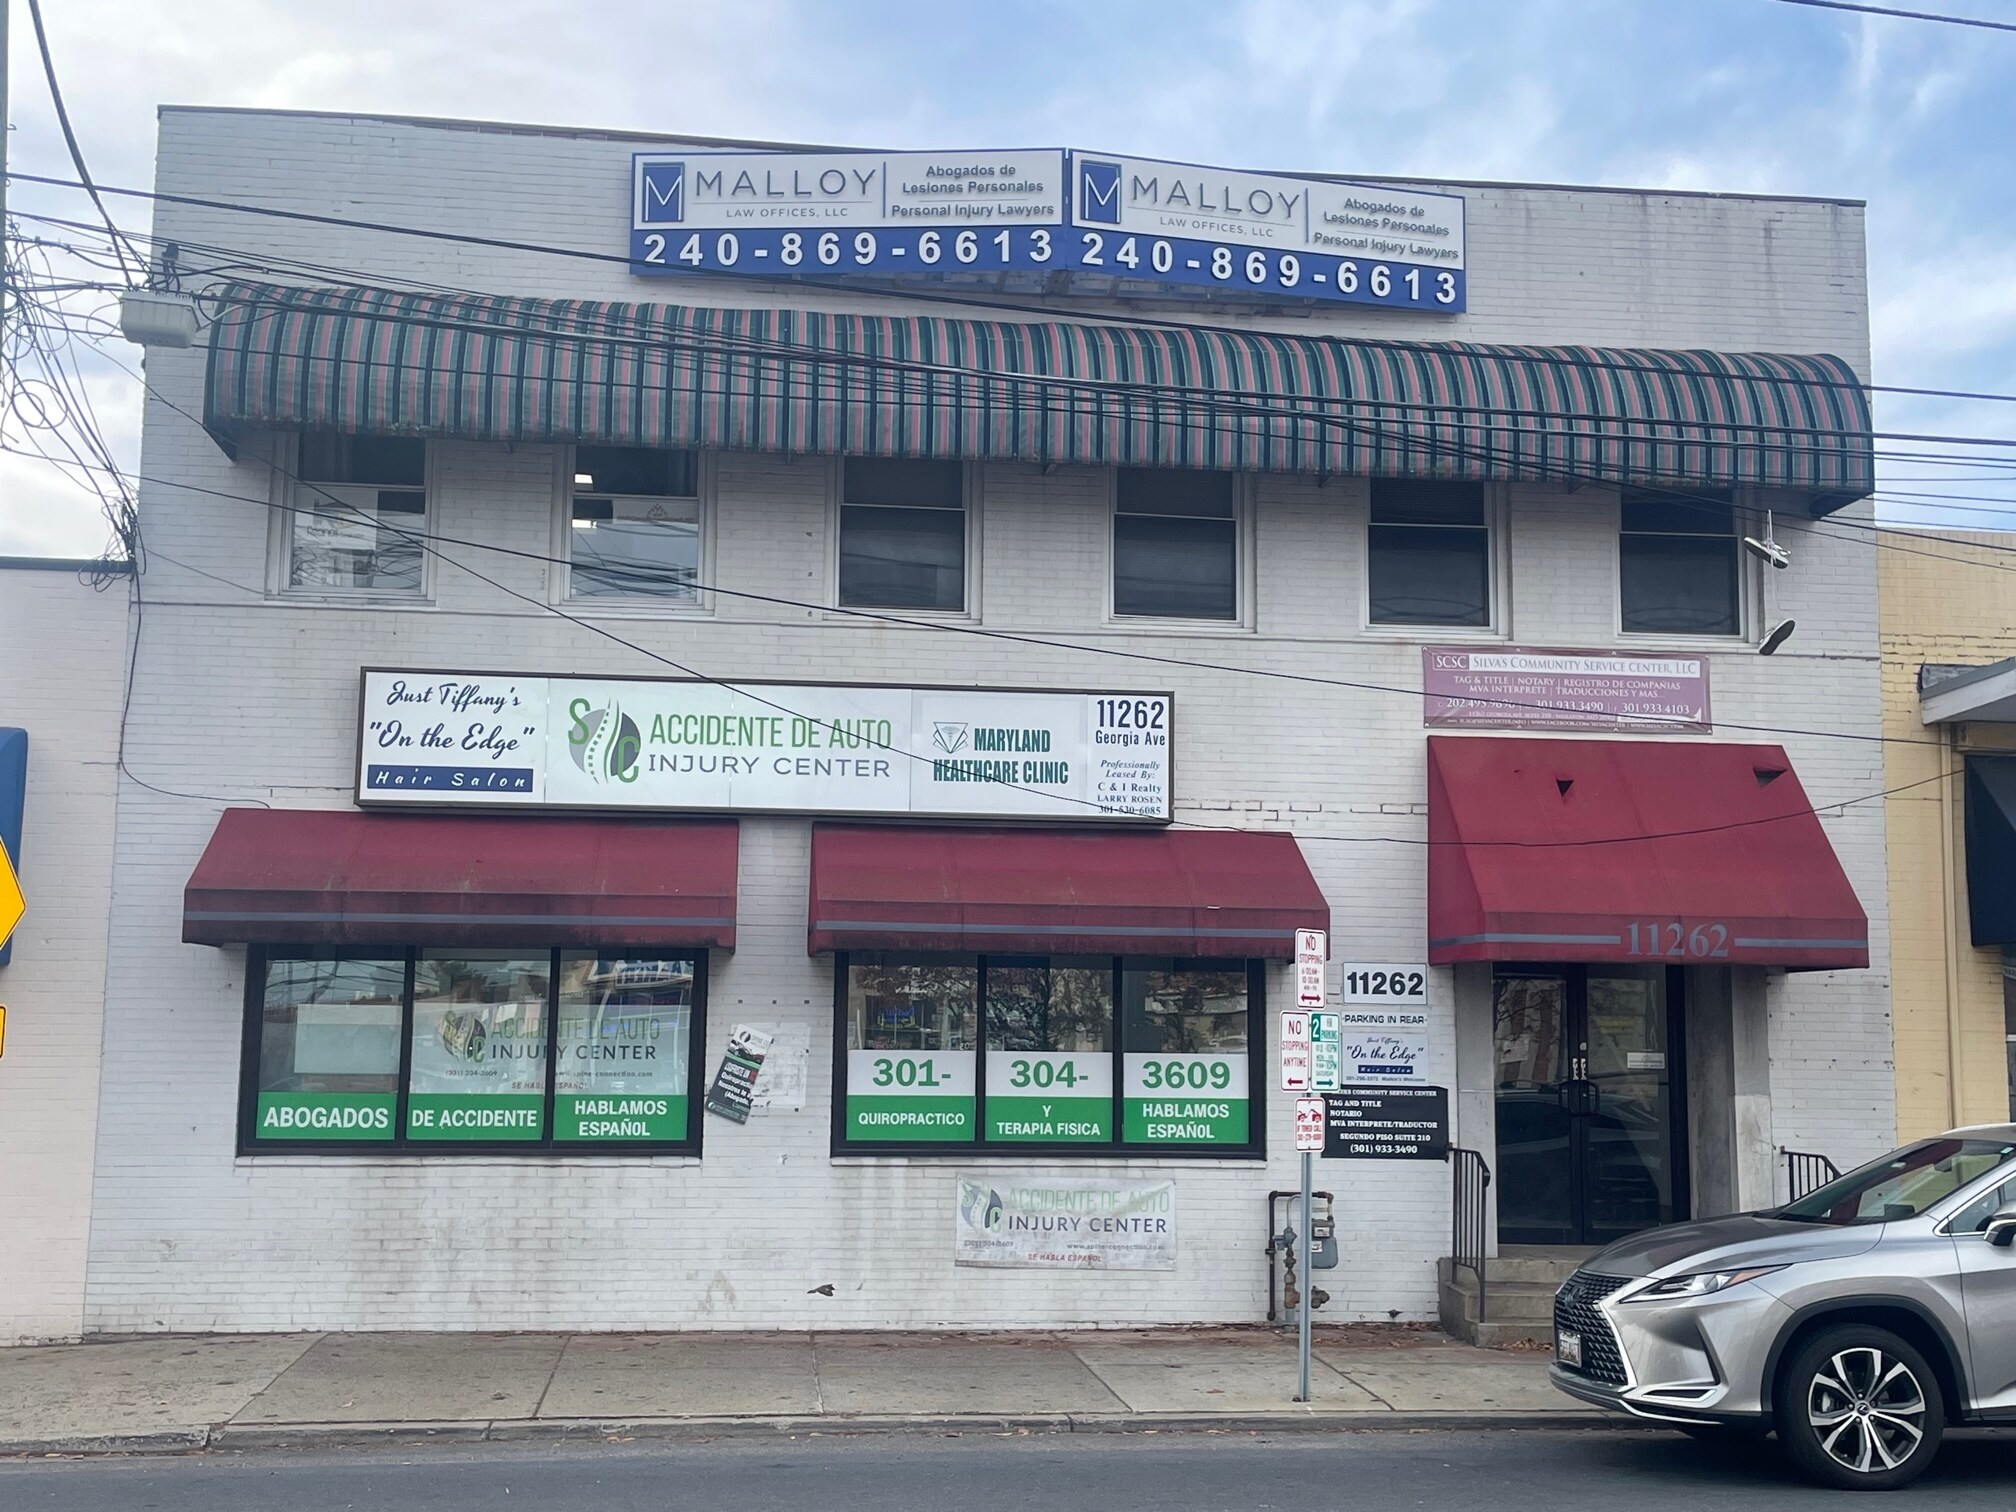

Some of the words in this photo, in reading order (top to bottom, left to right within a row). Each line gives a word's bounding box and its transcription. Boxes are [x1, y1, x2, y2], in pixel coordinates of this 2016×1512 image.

[926, 165, 995, 179] Abogados
[1000, 164, 1016, 175] de
[696, 169, 876, 197] MALLOY
[902, 182, 963, 194] Lesiones
[968, 180, 1044, 193] Personales
[1132, 175, 1300, 219] MALLOY
[726, 208, 755, 218] LAW
[760, 207, 820, 219] OFFICES,
[825, 207, 848, 217] LLC
[892, 205, 950, 217] Personal
[955, 204, 994, 218] Injury
[998, 204, 1054, 217] Lawyers
[1344, 198, 1407, 215] Abogados
[1410, 206, 1425, 217] de
[1160, 217, 1187, 228] LAW
[1192, 221, 1247, 236] OFFICES,
[1251, 227, 1273, 238] LLC
[1323, 211, 1379, 228] Lesiones
[1382, 218, 1450, 237] Personales
[643, 229, 1053, 267] 240-869-6613
[1314, 232, 1368, 249] Personal
[1371, 238, 1406, 255] Injury
[1409, 243, 1459, 260] Lawyers
[1081, 232, 1457, 304] 240-869-6613
[1436, 655, 1467, 669] SCSC
[1510, 656, 1580, 670] COMMUNITY
[1583, 660, 1625, 672] SERVICE
[1628, 662, 1672, 674] CENTER,
[1675, 661, 1697, 675] LLC
[1454, 676, 1472, 684] TAG
[1474, 676, 1481, 684] &
[1484, 676, 1509, 684] TITLE
[1517, 677, 1555, 686] NOTARY
[1563, 678, 1610, 688] REGISTRO
[1612, 679, 1624, 689] DE
[386, 681, 432, 707] Just
[438, 682, 521, 715] Tiffany's
[1469, 685, 1489, 693] MVA
[1491, 686, 1546, 695] INTERPRETE
[1556, 687, 1629, 698] TRADUCCIONES
[1630, 689, 1638, 698] Y
[1097, 700, 1164, 729] 11262
[1622, 702, 1690, 714] 301.933.4103
[369, 720, 414, 749] "On
[420, 724, 454, 750] the
[461, 724, 535, 760] Edge"
[650, 713, 784, 749] ACCIDENTE
[792, 717, 822, 748] DE
[829, 718, 892, 750] AUTO
[1095, 730, 1139, 747] Georgia
[1144, 732, 1166, 746] Ave
[974, 728, 1051, 753] MARYLAND
[649, 752, 760, 775] INJURY
[773, 757, 891, 778] CENTER
[933, 759, 1019, 783] HEALTHCARE
[1023, 760, 1069, 785] CLINIC
[1100, 760, 1161, 770] Professionally
[375, 770, 432, 786] Hair
[451, 771, 527, 789] Salon
[1105, 769, 1137, 779] Leased
[1140, 770, 1156, 781] By:
[1098, 782, 1106, 791] C
[1110, 783, 1117, 792] &
[1122, 783, 1127, 792] I
[1131, 783, 1162, 795] Realty
[1097, 795, 1128, 803] LARRY
[1131, 795, 1162, 804] ROSEN
[1305, 934, 1316, 951] NO
[1626, 921, 1729, 957] 11262
[1299, 953, 1322, 964] STOPPING
[1347, 972, 1424, 996] 11262
[1288, 1020, 1302, 1035] NO
[1312, 1018, 1320, 1038] 2
[1344, 1014, 1384, 1024] PARKING
[1388, 1015, 1397, 1024] IN
[1400, 1016, 1425, 1025] REAR
[615, 1018, 660, 1040] AUTO
[1321, 1030, 1338, 1039] PARKING
[575, 1045, 657, 1060] CENTER
[1281, 1040, 1309, 1051] STOPPING
[1283, 1056, 1307, 1067] ANYTIME
[1346, 1045, 1367, 1059] "On
[1370, 1046, 1386, 1059] the
[1389, 1046, 1424, 1064] Edge"
[872, 1058, 951, 1086] 301-
[1010, 1060, 1089, 1088] 304-
[1142, 1061, 1231, 1089] 3609
[523, 1082, 548, 1090] HABL
[574, 1100, 668, 1116] HABLAMOS
[1041, 1106, 1052, 1117] Y
[1142, 1104, 1229, 1118] HABLAMOS
[263, 1107, 389, 1128] ABOGADOS
[412, 1109, 434, 1127] DE
[439, 1110, 538, 1128] ACCIDENTE
[858, 1112, 965, 1126] QUIROPRACTICO
[1347, 1121, 1438, 1129] INTERPRETE/TRADUCTOR
[578, 1118, 651, 1137] ESPAÑOL
[996, 1122, 1053, 1135] TERAPIA
[1057, 1123, 1101, 1136] FISICA
[1147, 1121, 1215, 1139] ESPAÑOL
[1417, 1134, 1431, 1142] 210
[1350, 1144, 1374, 1154] (301)
[1375, 1145, 1418, 1154] 933-3490
[1009, 1188, 1095, 1210] ACCIDENTE
[1100, 1189, 1121, 1211] DE
[1129, 1190, 1170, 1213] AUTO
[1008, 1216, 1082, 1231] INJURY
[1089, 1218, 1167, 1233] CENTER
